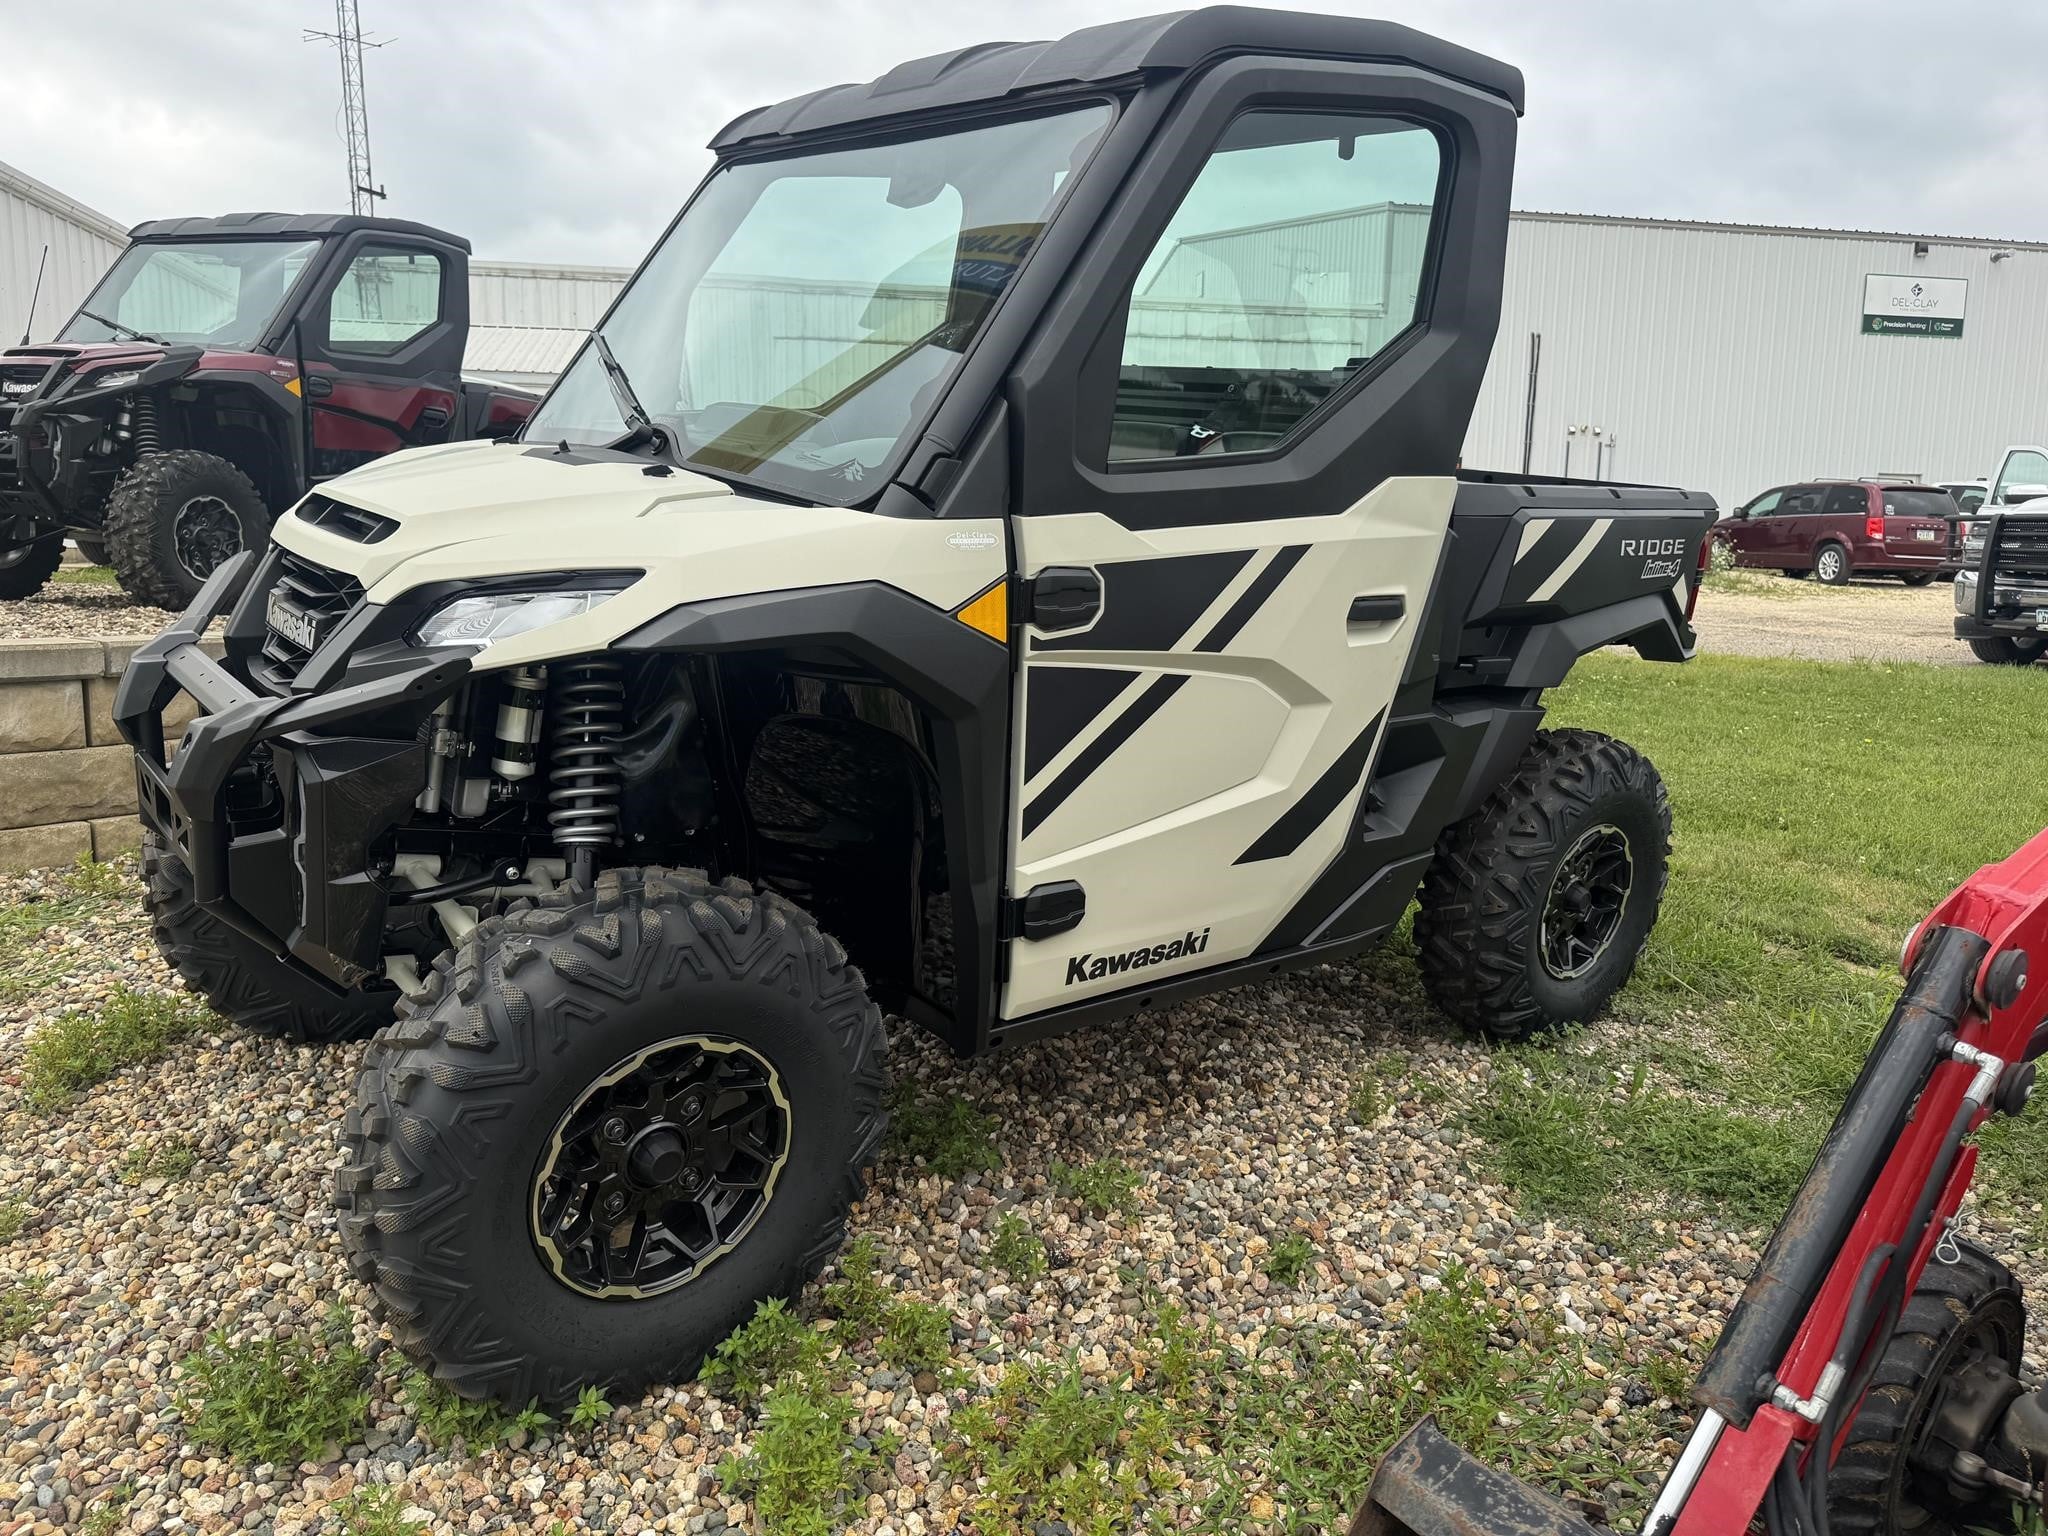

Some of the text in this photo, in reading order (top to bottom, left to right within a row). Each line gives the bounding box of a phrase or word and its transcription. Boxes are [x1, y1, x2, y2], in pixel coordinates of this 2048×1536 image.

[2, 381, 41, 393] Kawasa
[1620, 539, 1686, 556] RIDGE
[266, 593, 317, 651] Kawasaki
[1064, 927, 1211, 986] Kawasaki
